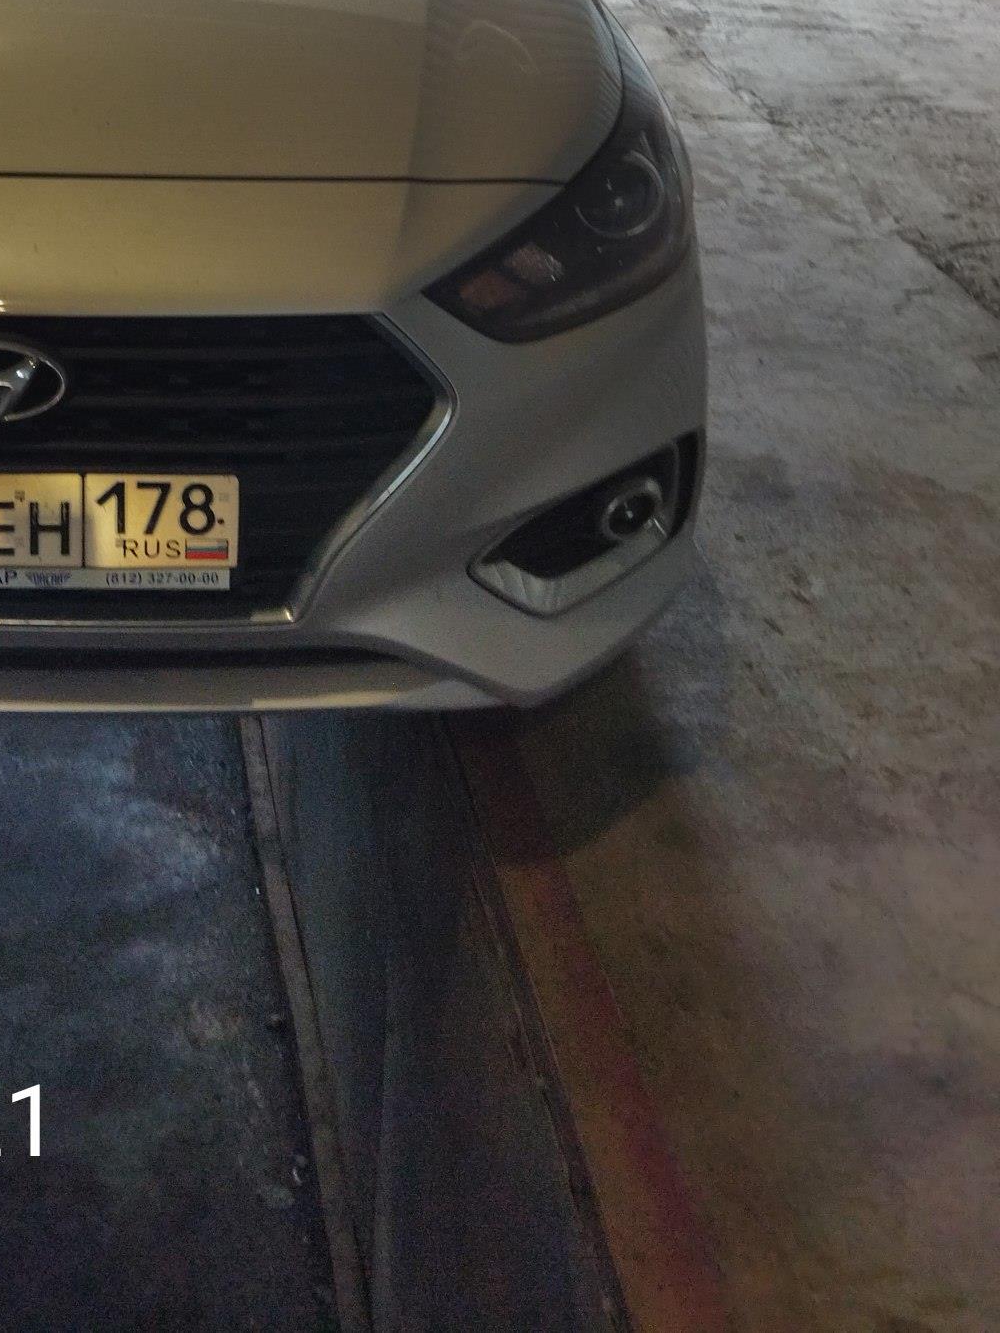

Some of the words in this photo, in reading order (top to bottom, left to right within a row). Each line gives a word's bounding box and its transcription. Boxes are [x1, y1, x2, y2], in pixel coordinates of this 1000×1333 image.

[96, 480, 215, 536] 178
[122, 539, 181, 559] RUS
[105, 571, 142, 586] (812)
[148, 571, 219, 586] 327-00-00
